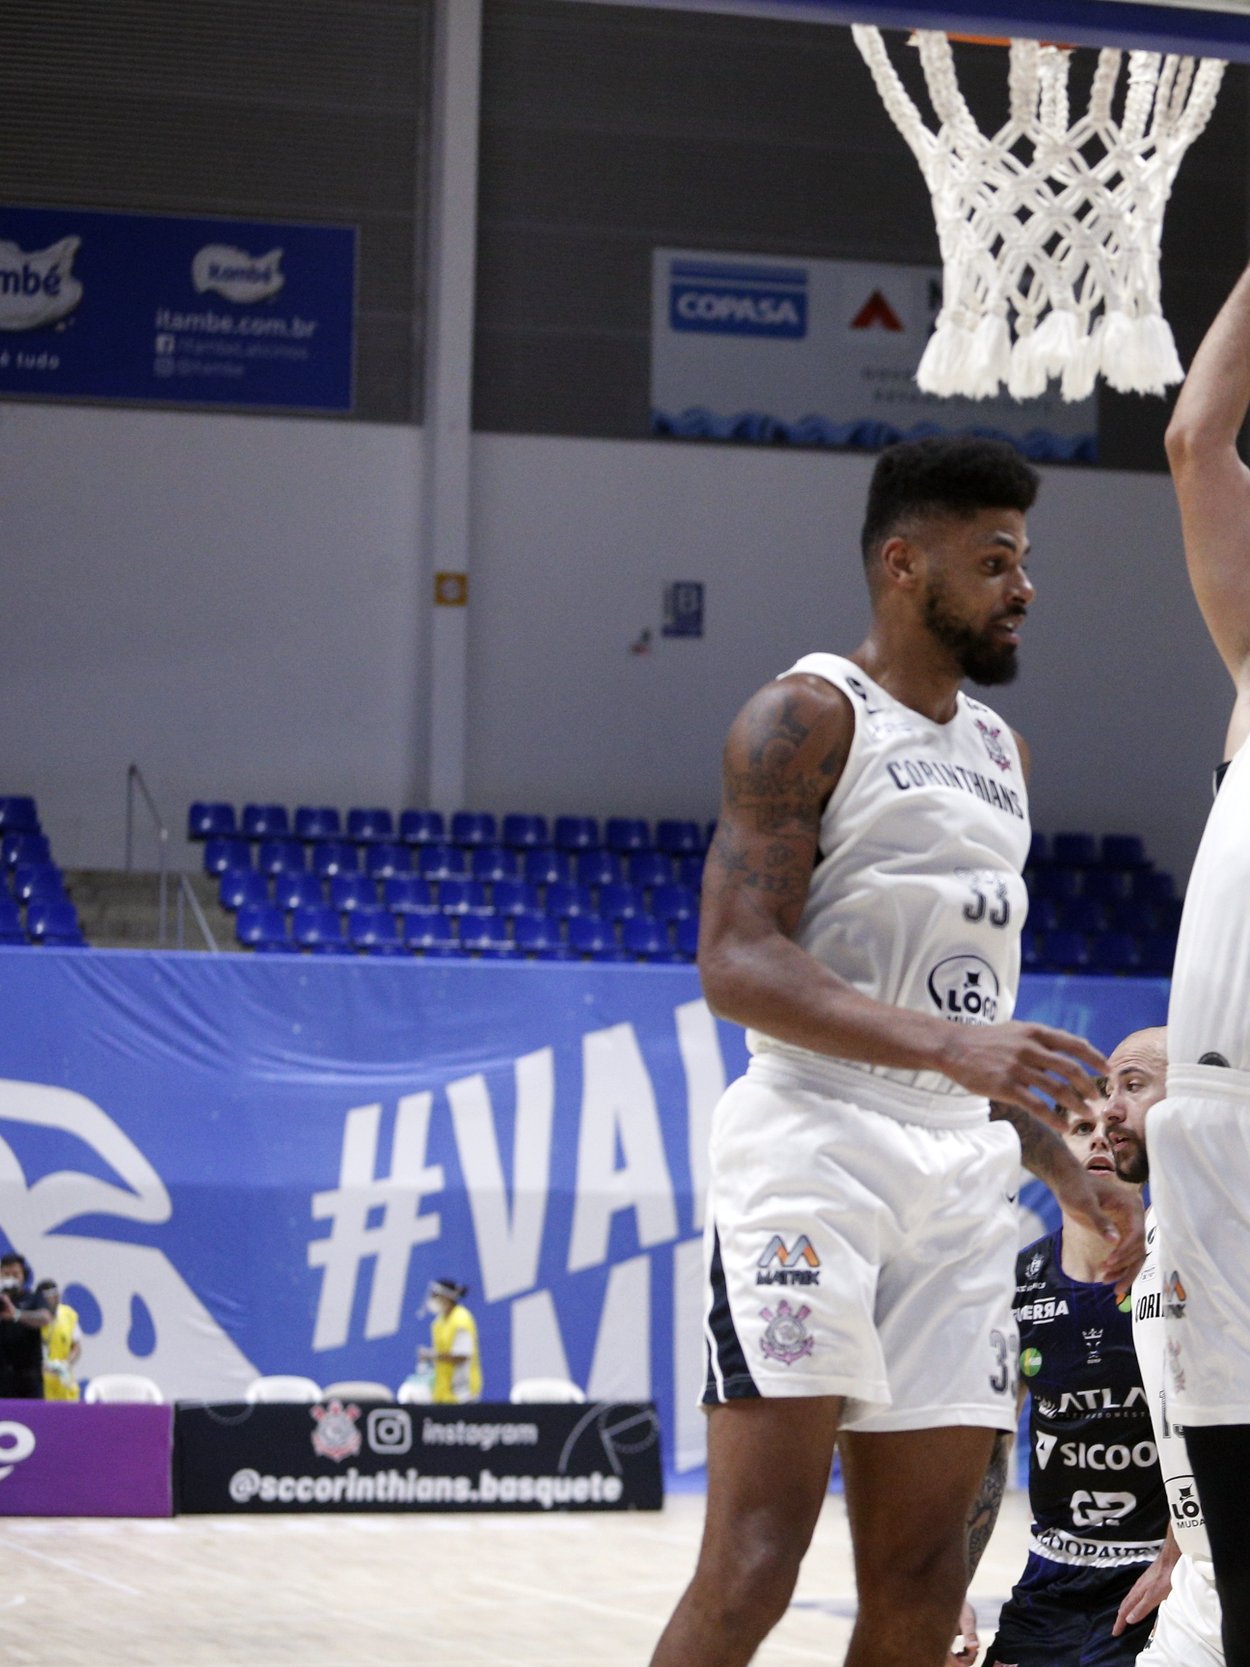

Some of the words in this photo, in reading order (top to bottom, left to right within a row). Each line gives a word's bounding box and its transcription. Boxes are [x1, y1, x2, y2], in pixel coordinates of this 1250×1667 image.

[674, 292, 799, 325] COPASA
[16, 350, 61, 371] tudo
[887, 760, 1024, 820] CORINTHIANS
[421, 1417, 539, 1451] instagram
[229, 1467, 623, 1509] @sccorinthians.basquete
